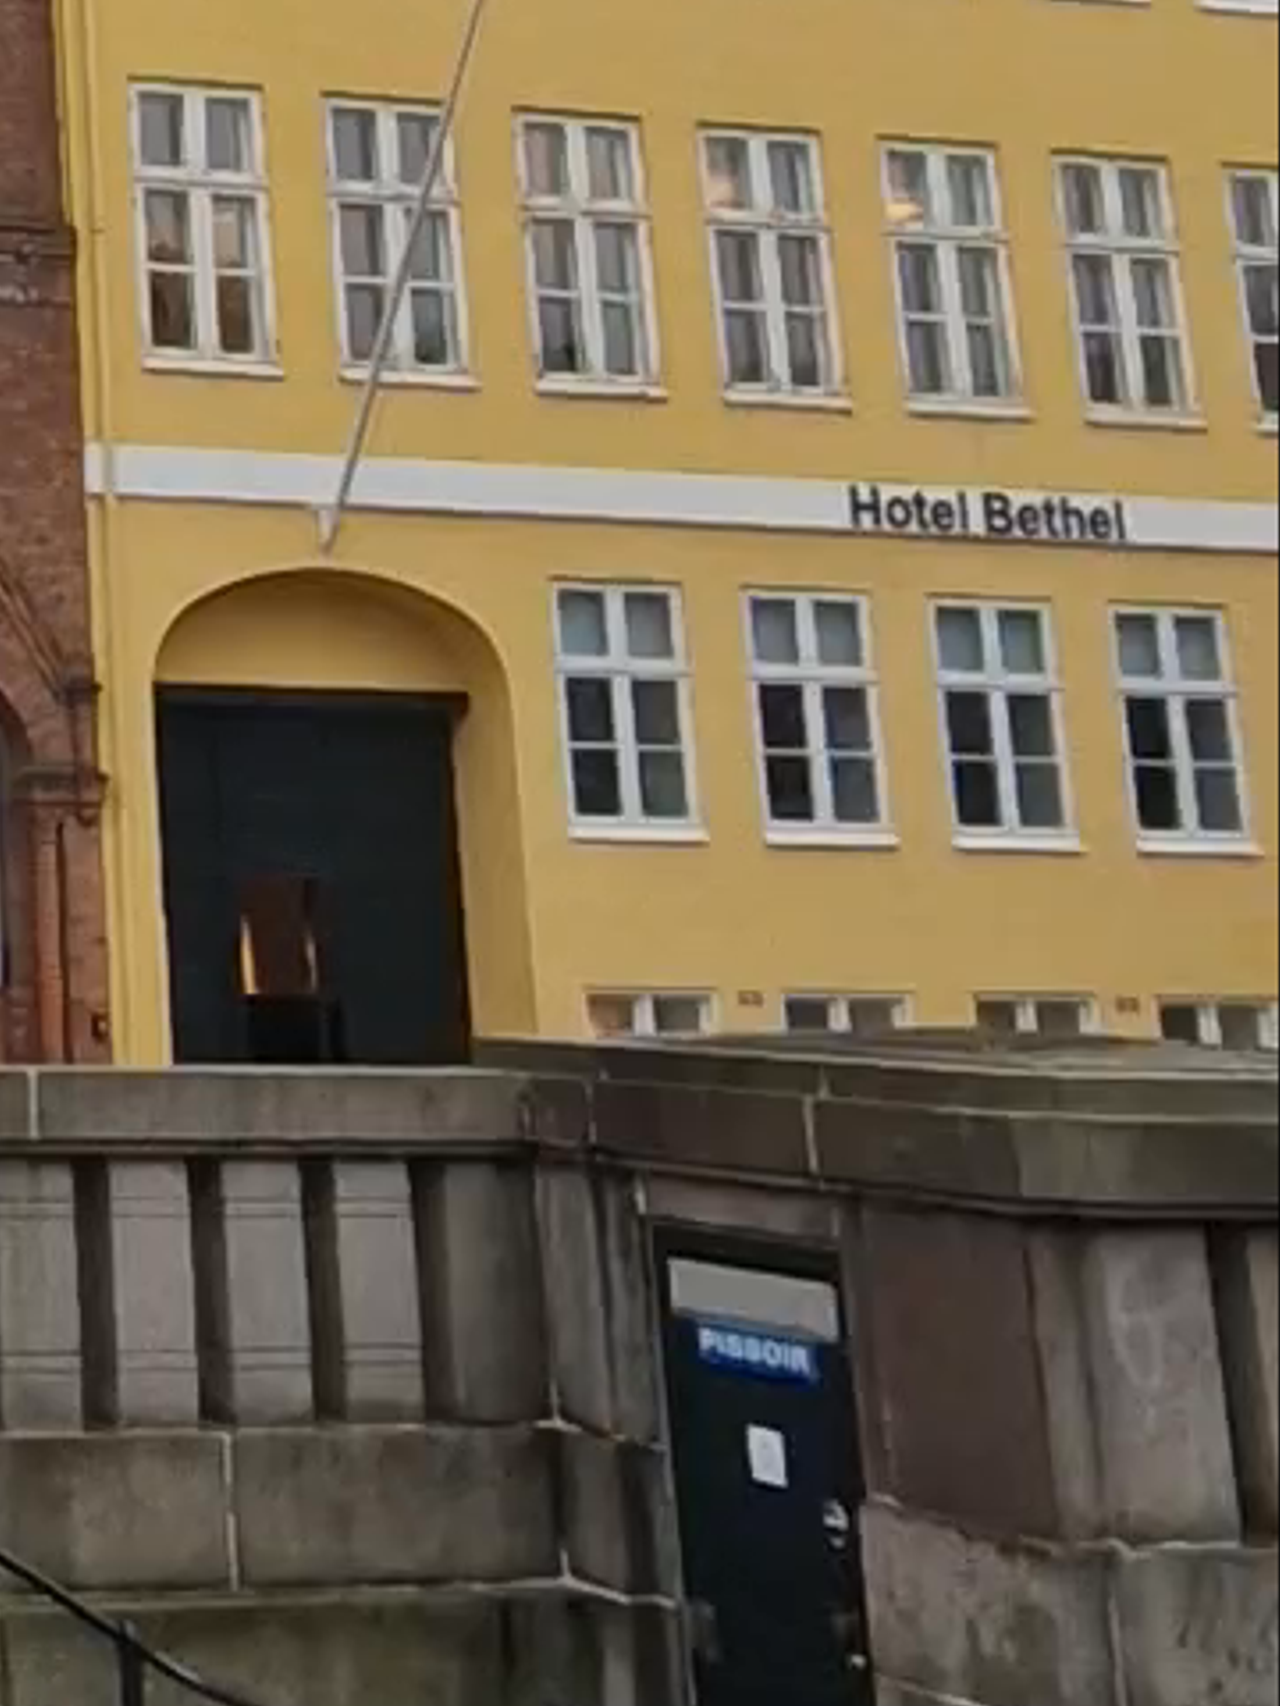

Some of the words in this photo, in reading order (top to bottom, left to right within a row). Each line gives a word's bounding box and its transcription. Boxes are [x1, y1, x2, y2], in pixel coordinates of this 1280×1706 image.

[849, 484, 970, 531] Hotel
[982, 491, 1127, 540] Bethel
[698, 1327, 811, 1375] PISSOIR
